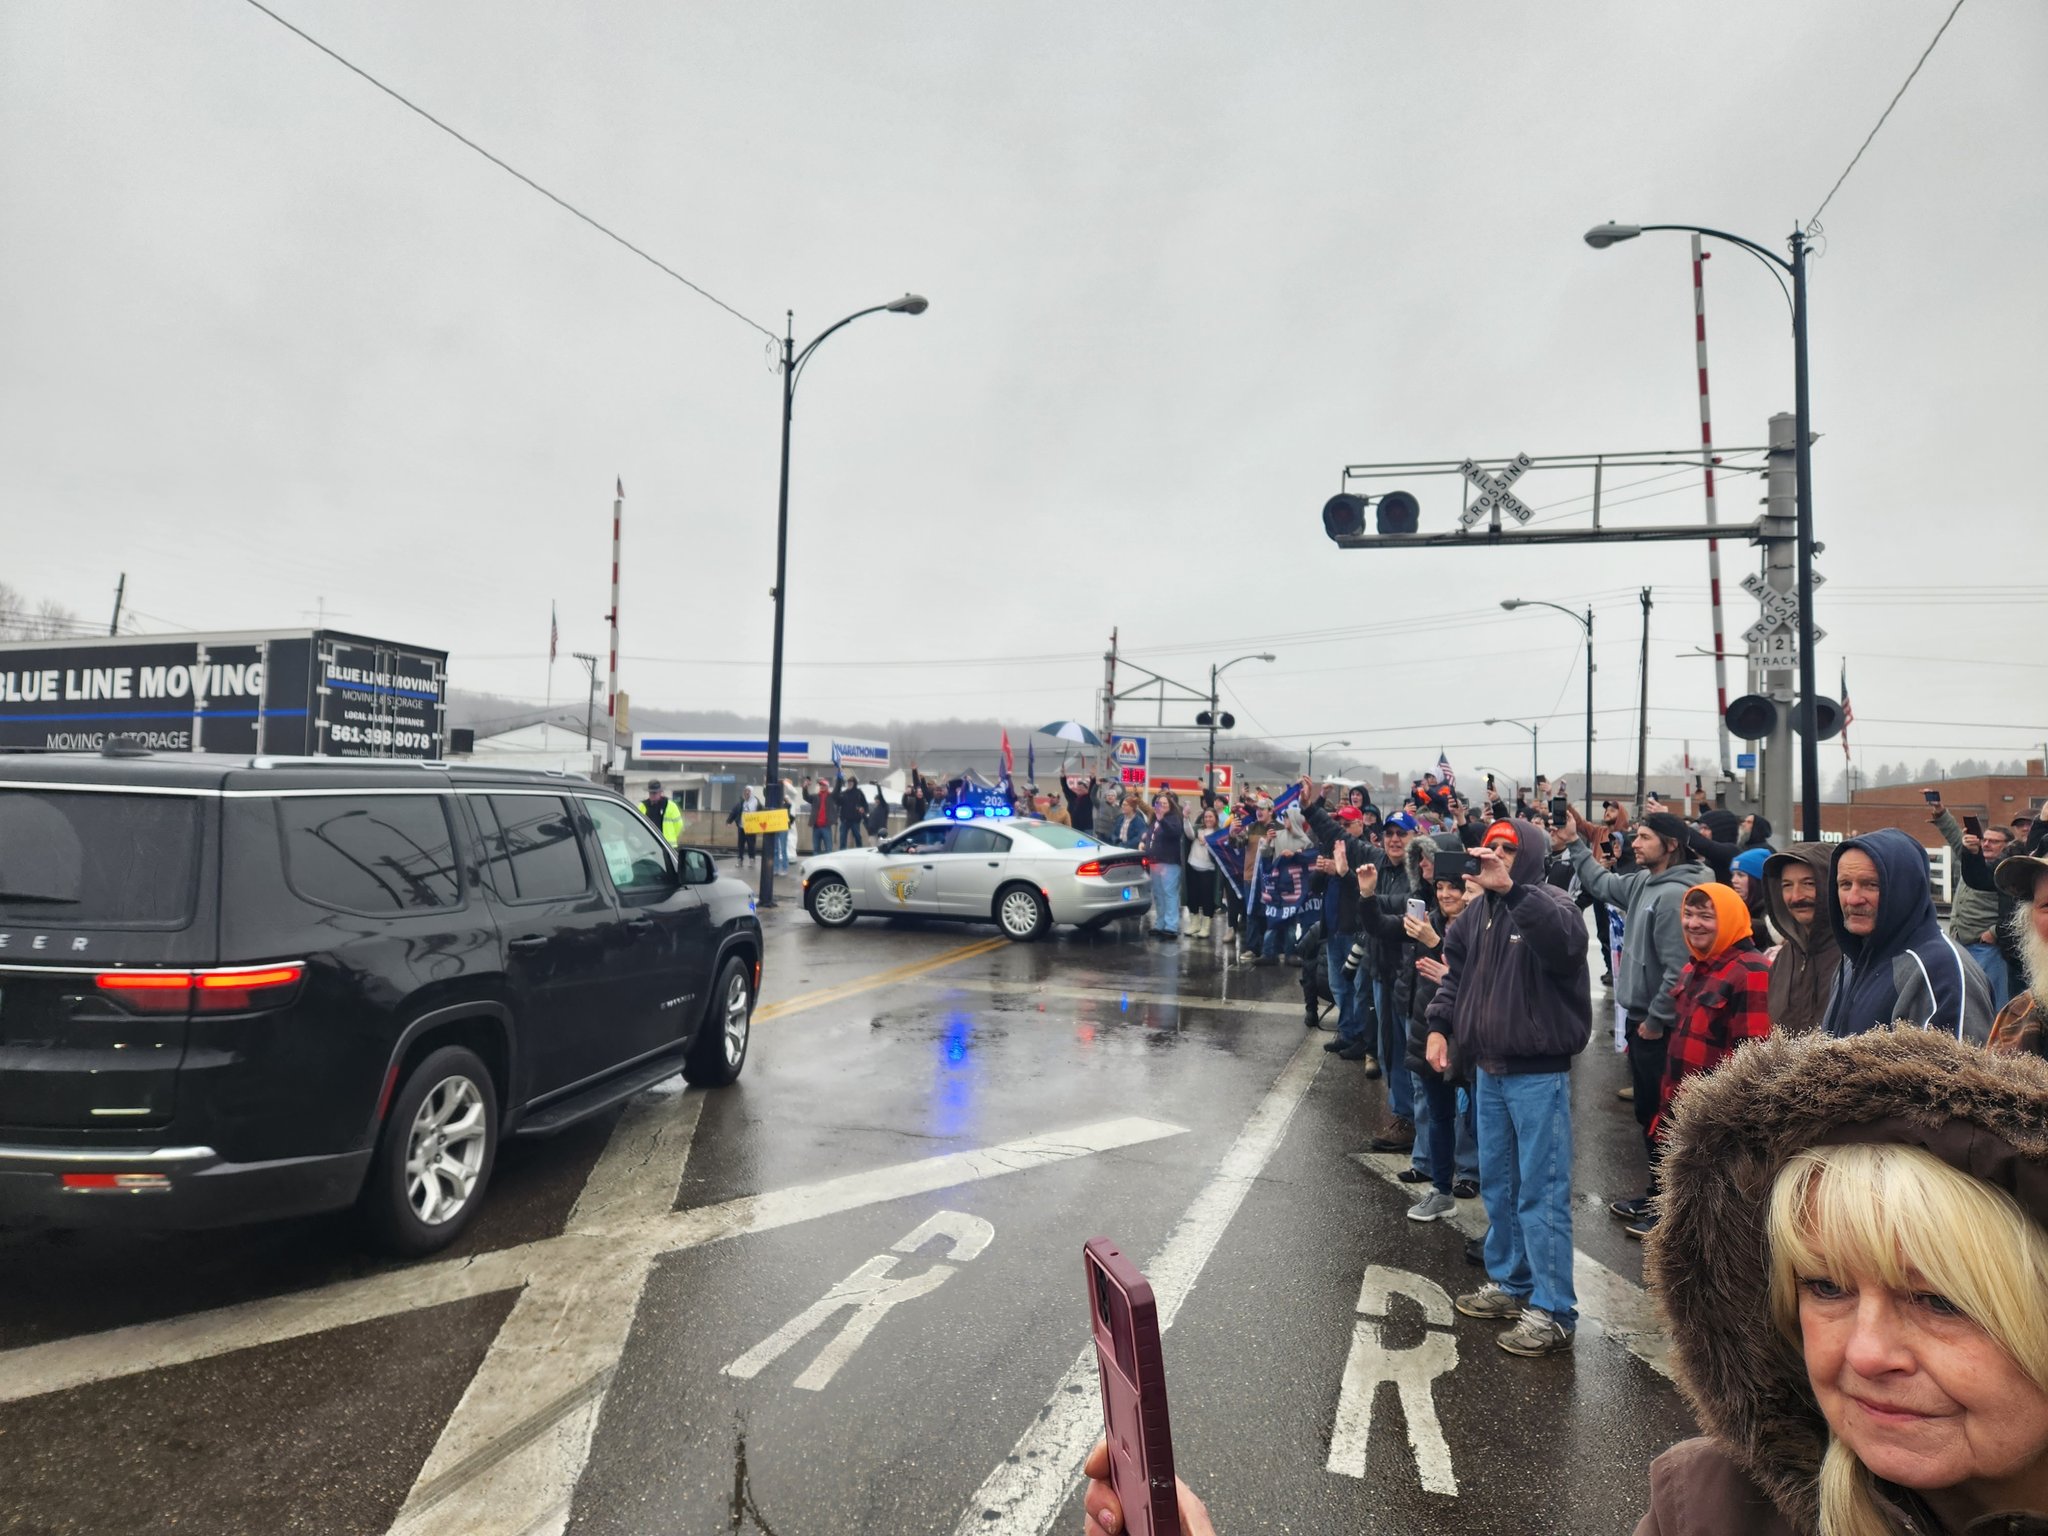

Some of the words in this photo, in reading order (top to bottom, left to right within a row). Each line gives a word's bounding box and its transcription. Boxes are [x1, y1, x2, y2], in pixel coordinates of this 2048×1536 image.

[1462, 456, 1530, 525] CROSSING
[1746, 573, 1822, 643] CROSSIG
[1775, 638, 1785, 650] 2
[65, 667, 132, 700] LINE
[139, 663, 264, 698] MOVING
[326, 664, 360, 683] BLUE
[362, 670, 390, 687] LINE
[392, 675, 438, 693] MOVING
[342, 689, 376, 704] MOVING
[387, 695, 423, 709] STORAGE
[344, 710, 366, 721] LOCAL
[374, 714, 393, 724] LONG
[395, 715, 425, 727] DISTANCE
[47, 731, 103, 750] MOVING
[331, 723, 430, 749] 561-398-8078
[1326, 1264, 1460, 1497] R
